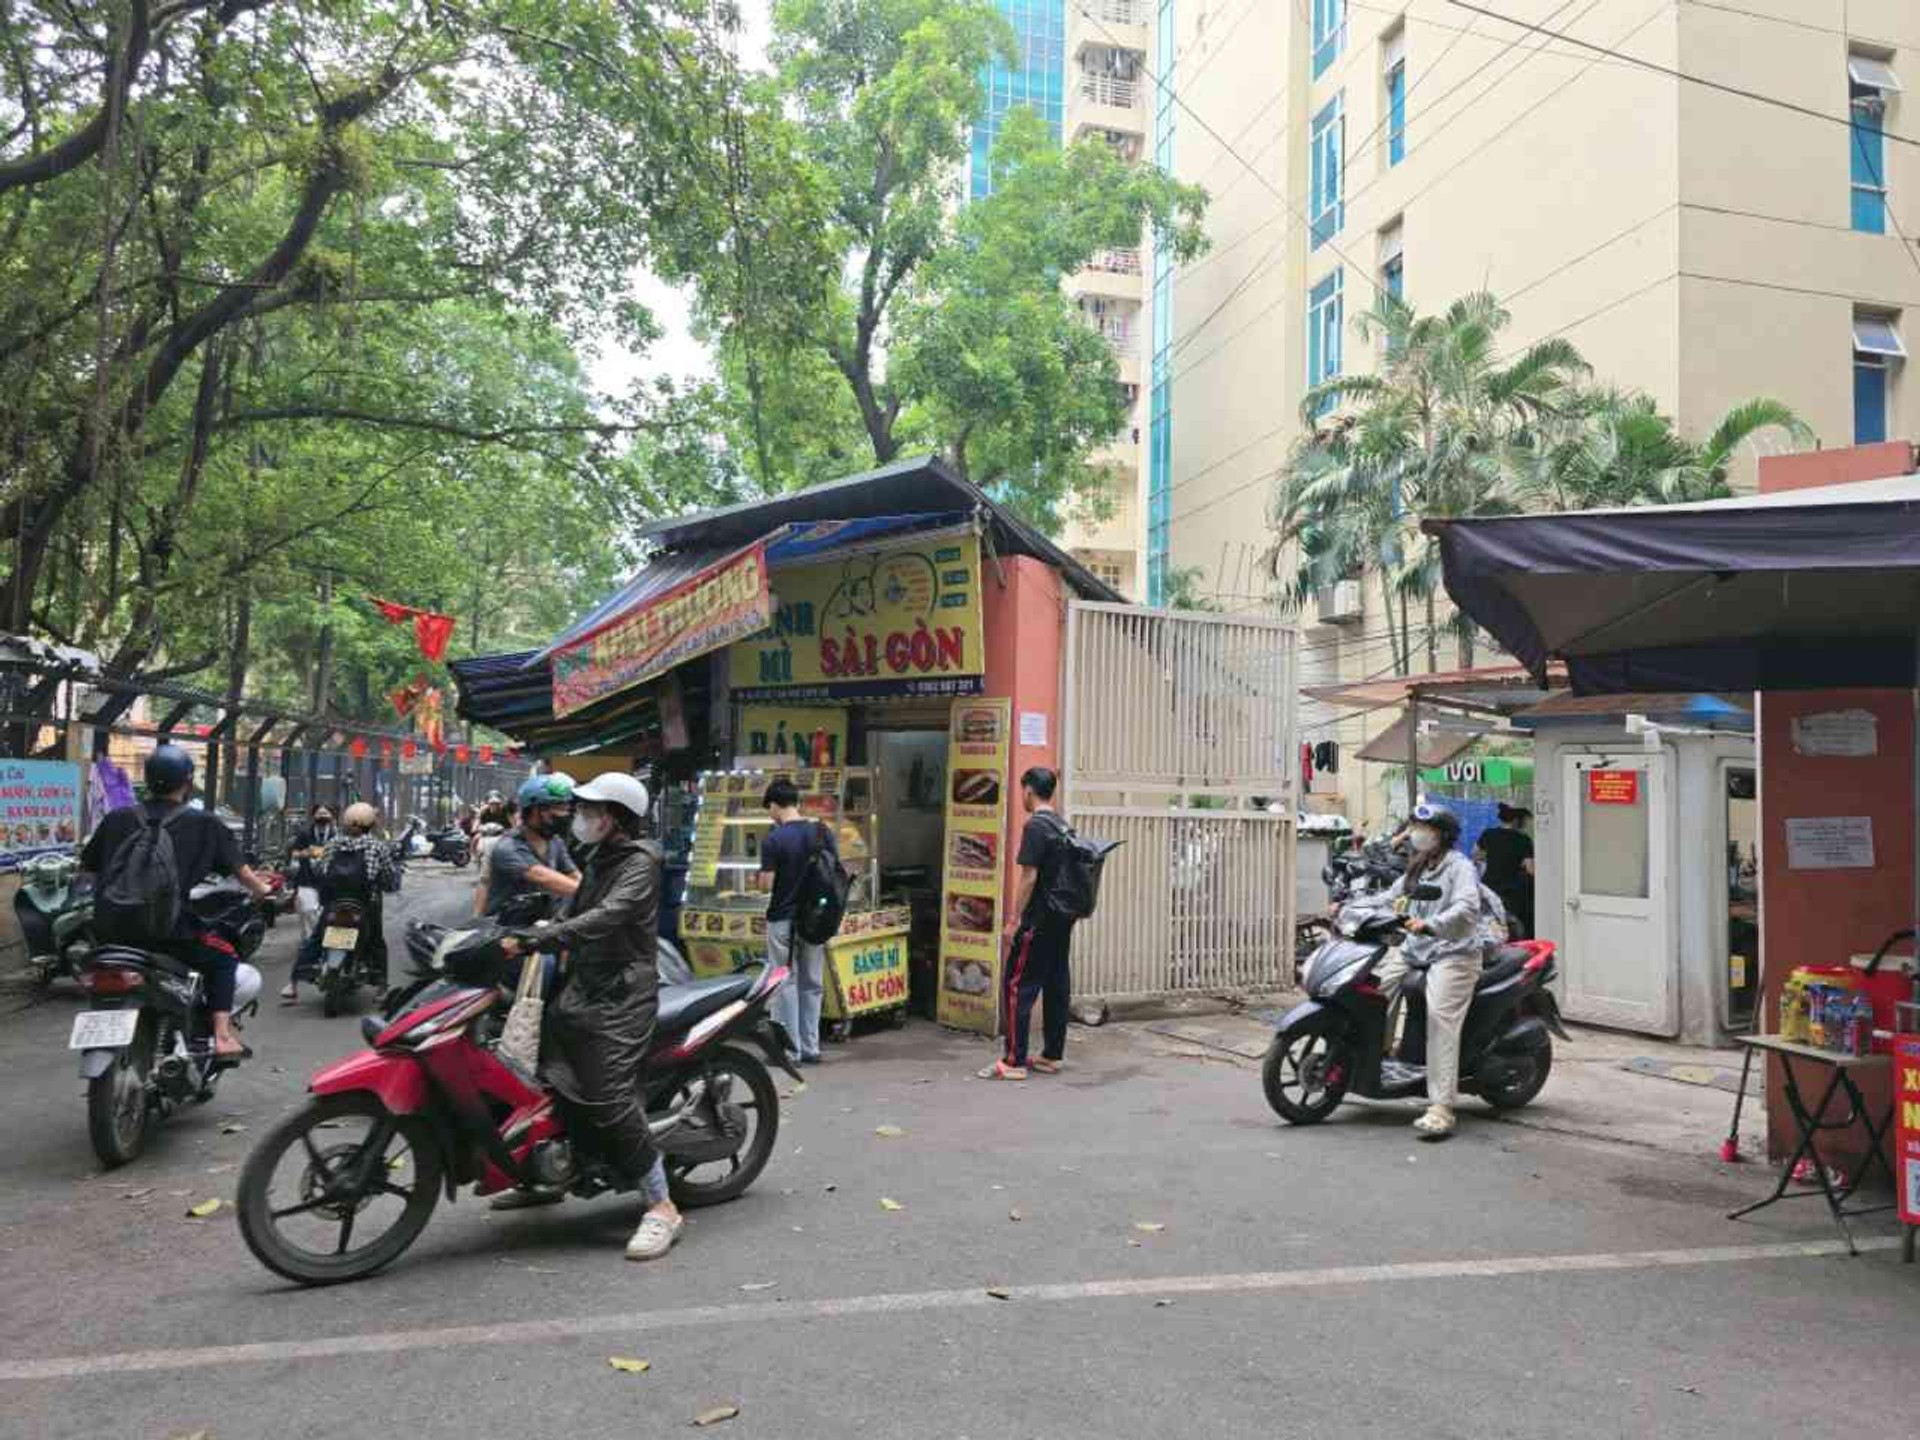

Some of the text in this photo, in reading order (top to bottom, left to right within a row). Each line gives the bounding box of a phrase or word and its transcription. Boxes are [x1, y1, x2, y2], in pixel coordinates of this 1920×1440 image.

[760, 640, 792, 683] MÌ
[820, 624, 879, 677] SÀI
[886, 617, 964, 673] GÒN
[876, 972, 905, 1000] GÒN
